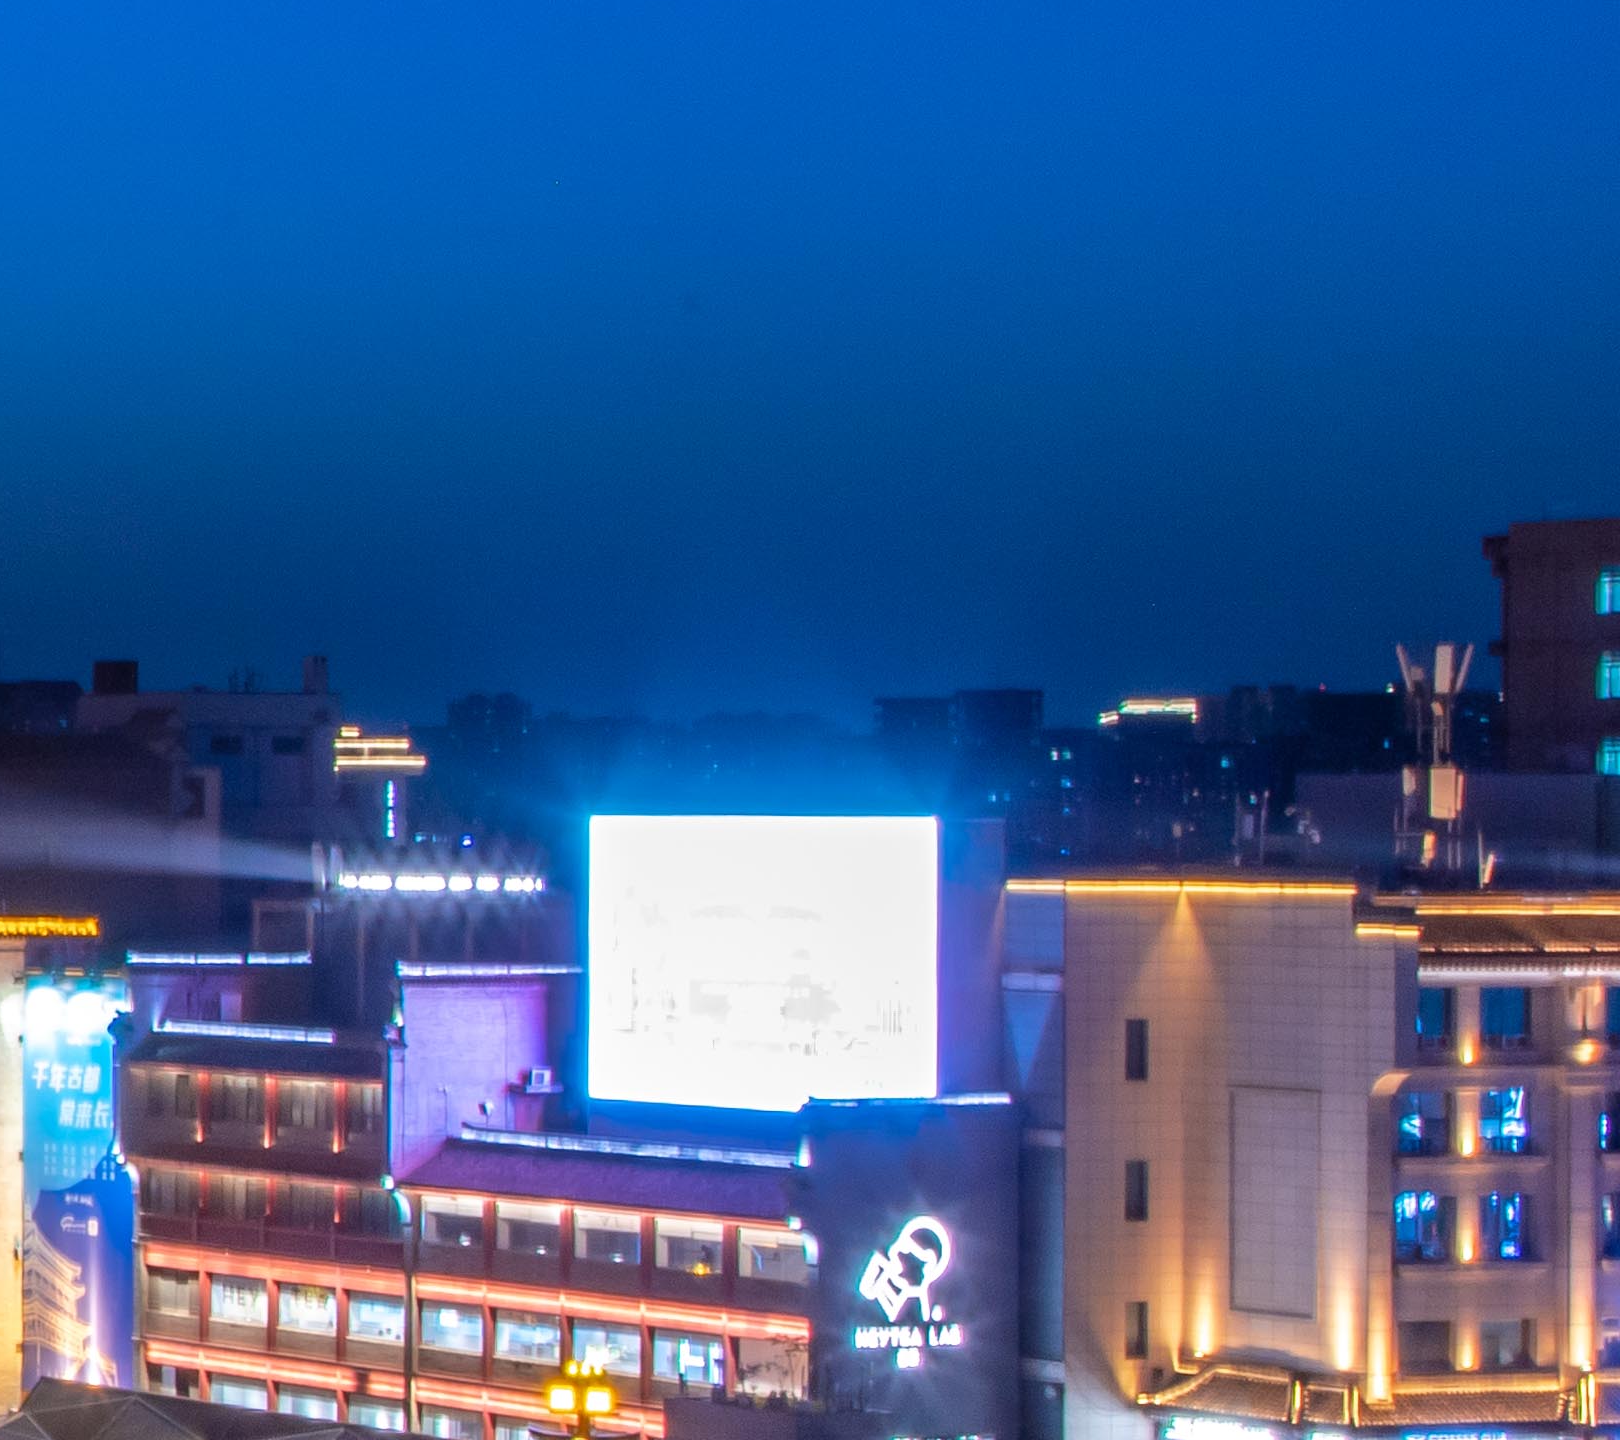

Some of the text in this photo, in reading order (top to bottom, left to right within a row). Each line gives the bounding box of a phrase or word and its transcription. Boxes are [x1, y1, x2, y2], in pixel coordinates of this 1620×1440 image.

[32, 1061, 100, 1093] 千年古都
[59, 1098, 114, 1129] 常来长
